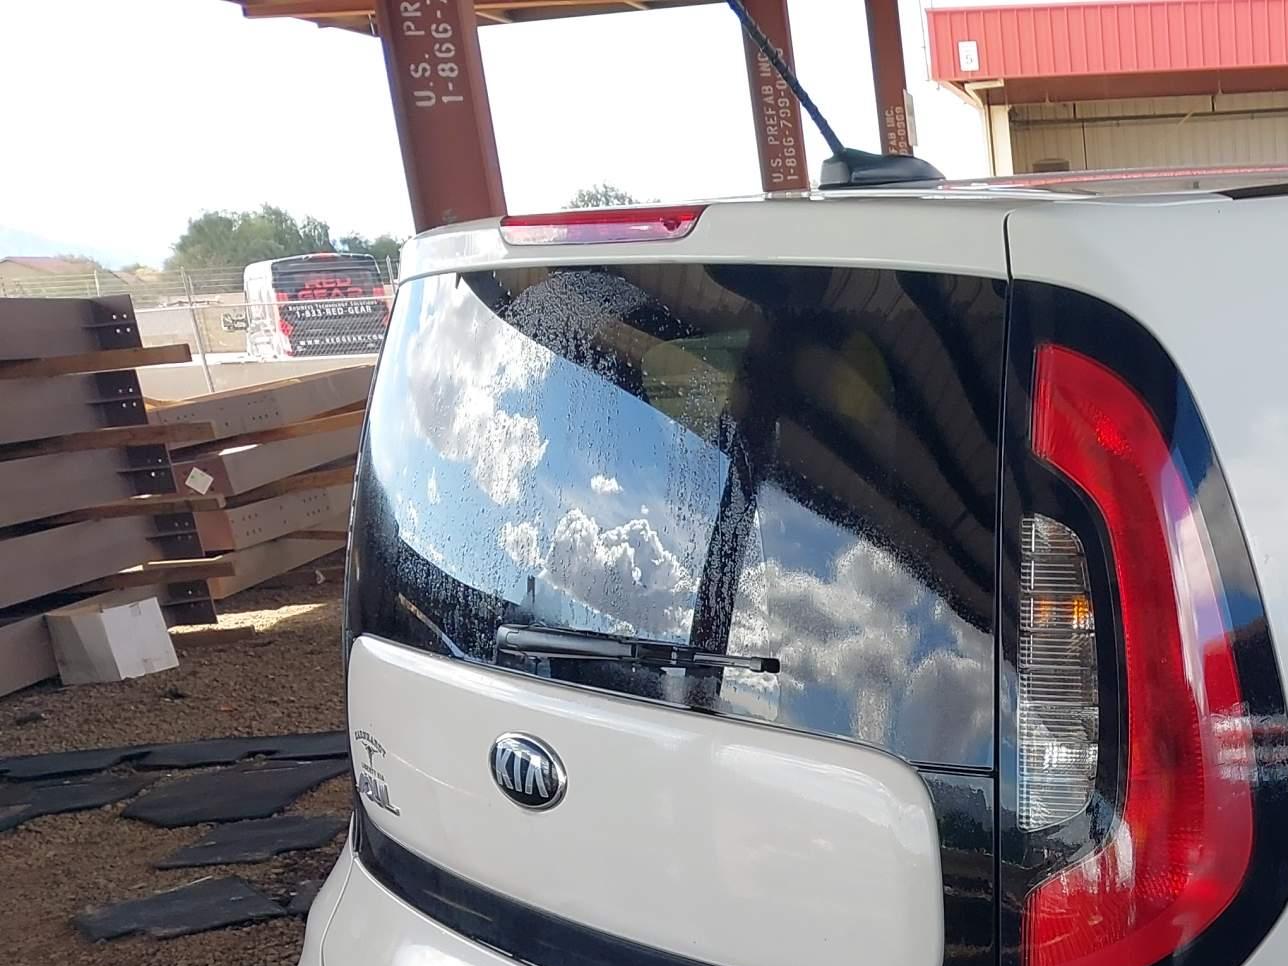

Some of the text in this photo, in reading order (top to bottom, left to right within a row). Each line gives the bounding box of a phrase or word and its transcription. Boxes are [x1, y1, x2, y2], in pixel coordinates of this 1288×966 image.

[410, 53, 437, 107] U.S.
[761, 85, 780, 145] PREFAB
[771, 154, 784, 183] U.S.
[296, 305, 372, 318] 1-833-RED-GEAR
[495, 742, 549, 798] KIA
